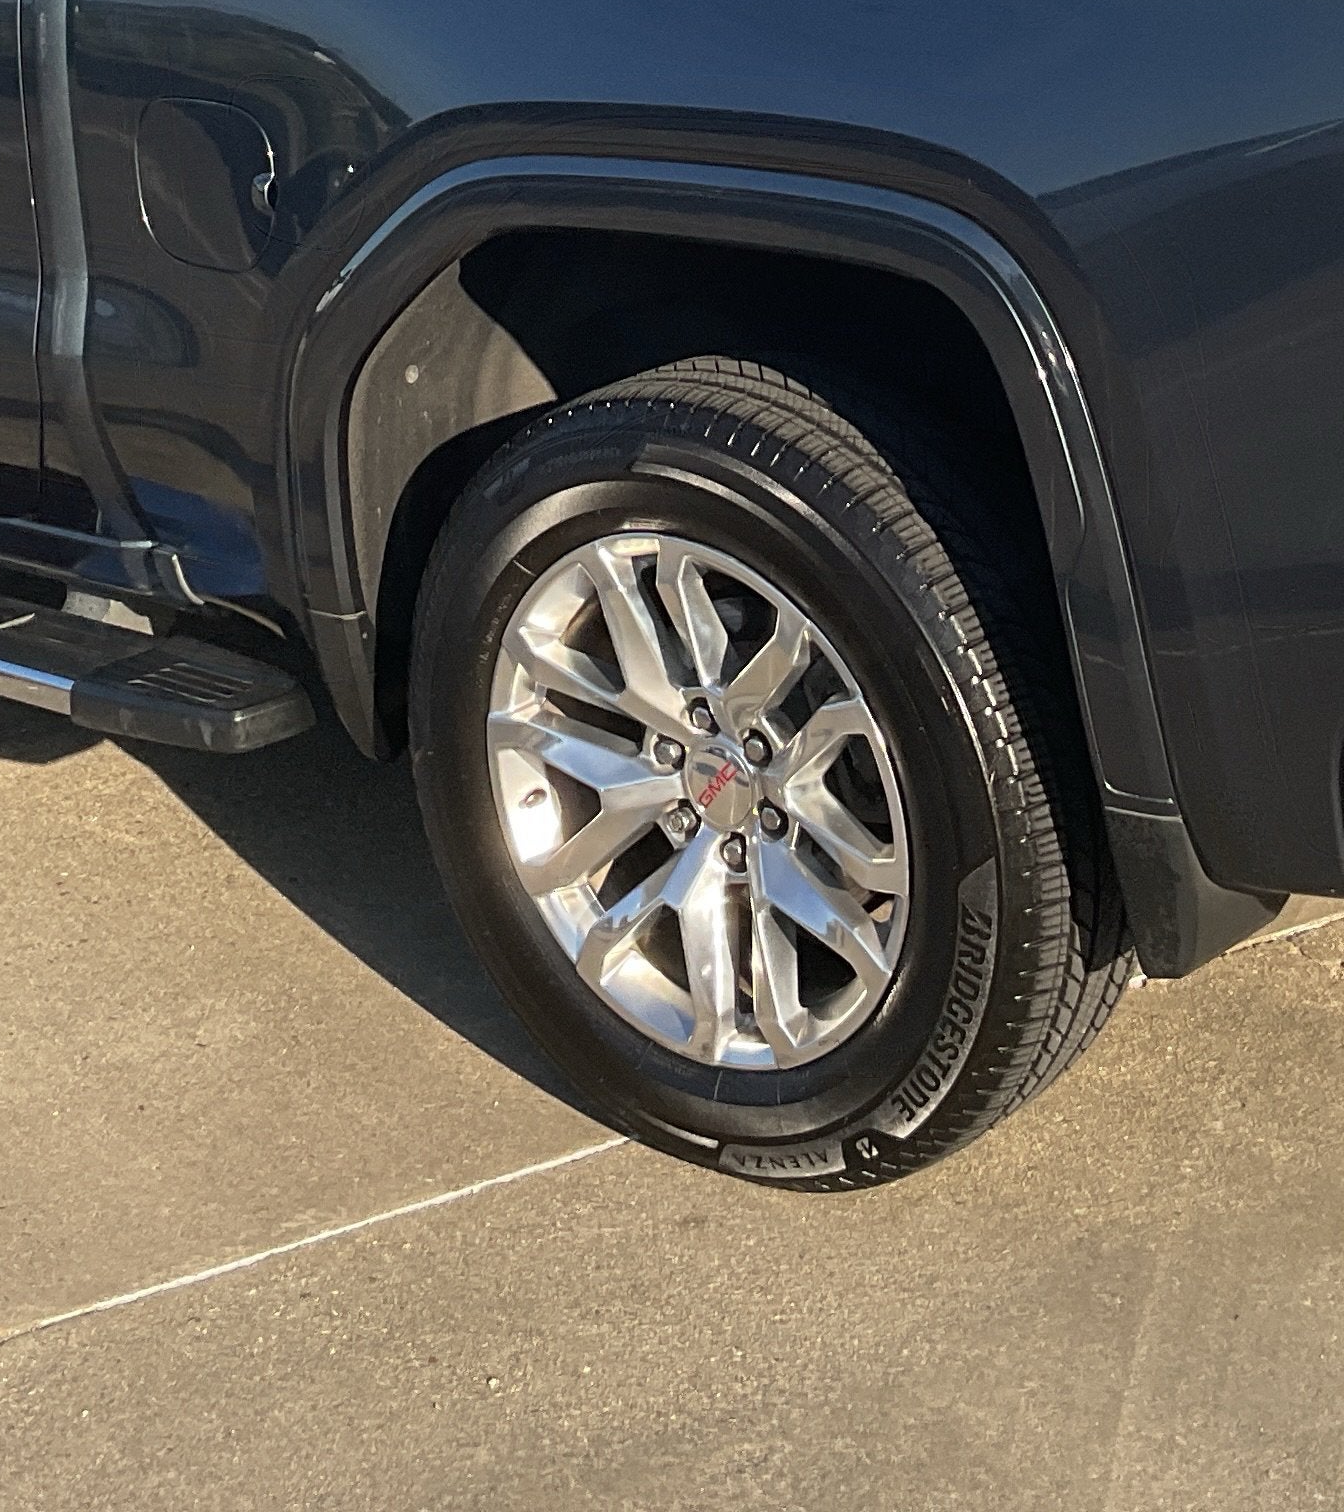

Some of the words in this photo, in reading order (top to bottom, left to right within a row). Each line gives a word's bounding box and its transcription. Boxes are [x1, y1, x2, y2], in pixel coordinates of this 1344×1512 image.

[699, 760, 738, 808] GMC
[891, 902, 993, 1122] BRIDGESTONE
[731, 1148, 829, 1170] ALENZA
